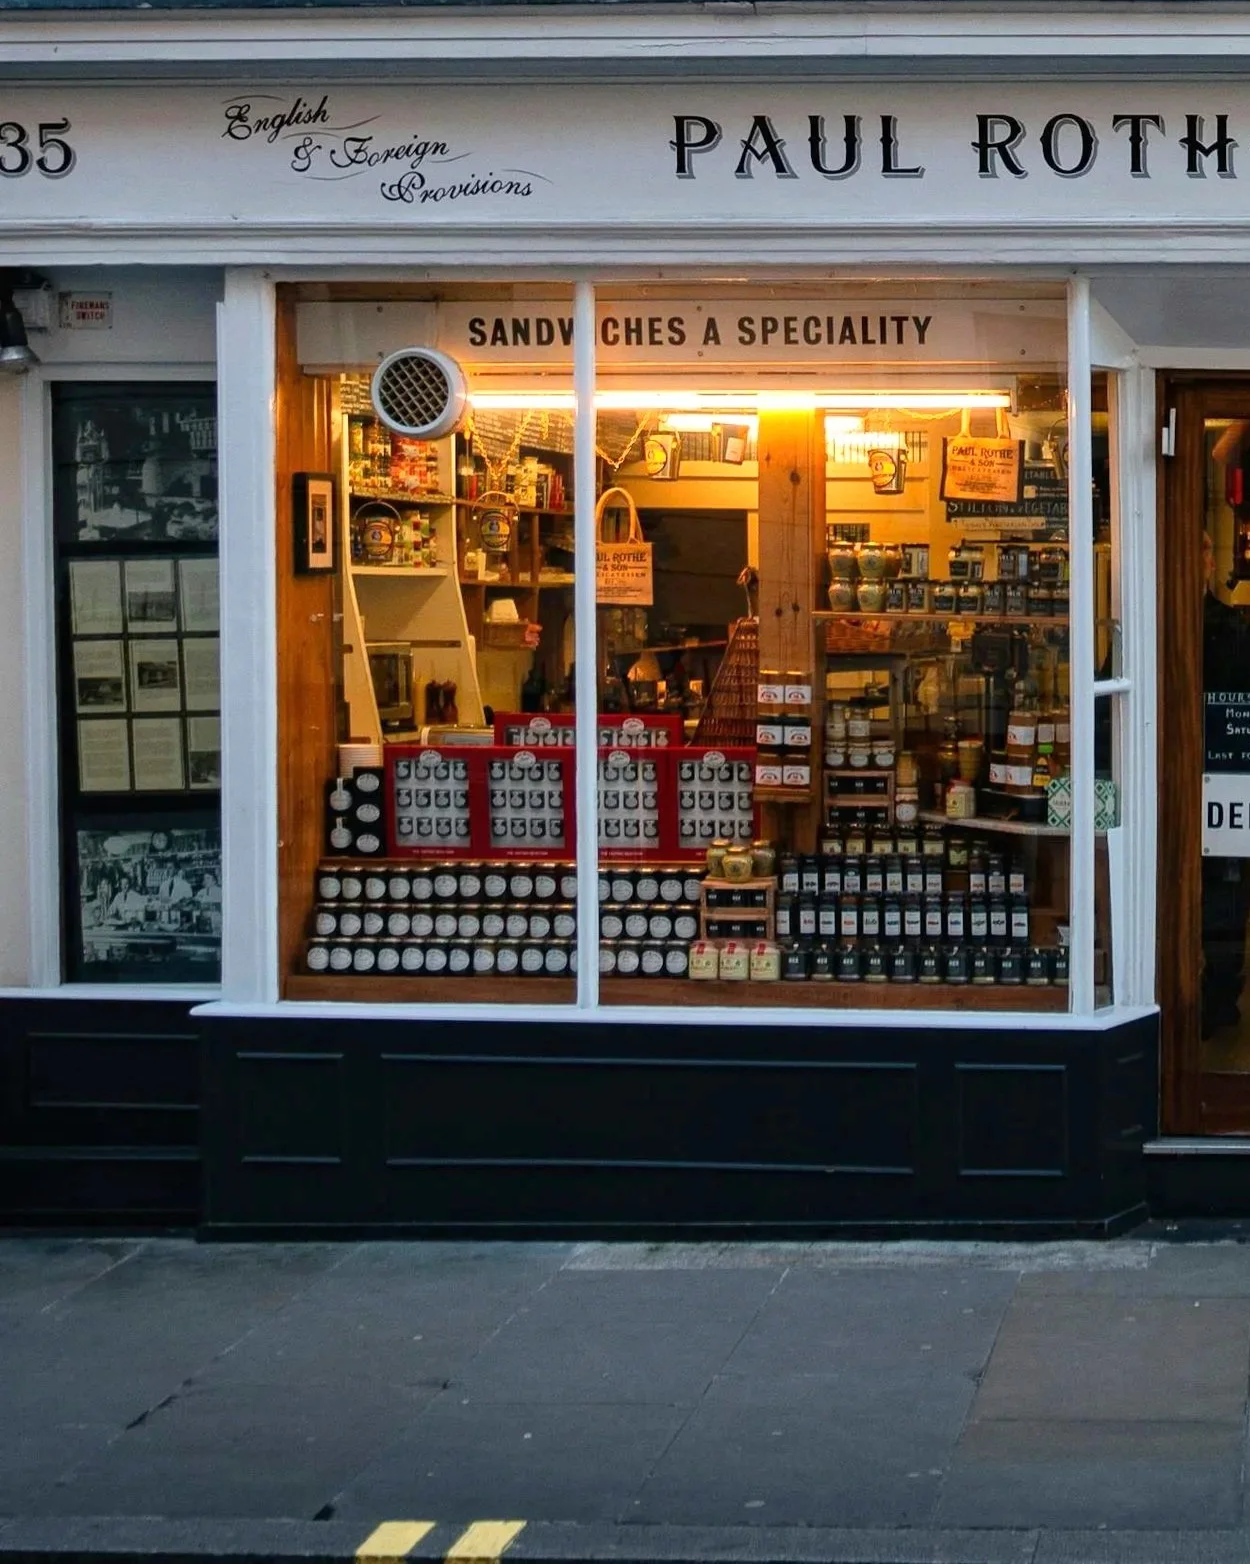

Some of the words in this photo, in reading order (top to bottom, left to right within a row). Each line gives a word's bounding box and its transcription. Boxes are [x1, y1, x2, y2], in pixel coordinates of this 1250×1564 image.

[222, 95, 330, 143] English
[0, 117, 77, 180] 35
[291, 136, 322, 172] &
[330, 134, 450, 169] Foreign
[669, 113, 925, 181] PAUL
[381, 171, 533, 203] Provisions
[468, 317, 687, 347] SANDWCHES
[702, 316, 722, 346] A
[737, 315, 933, 346] SPECIALITY
